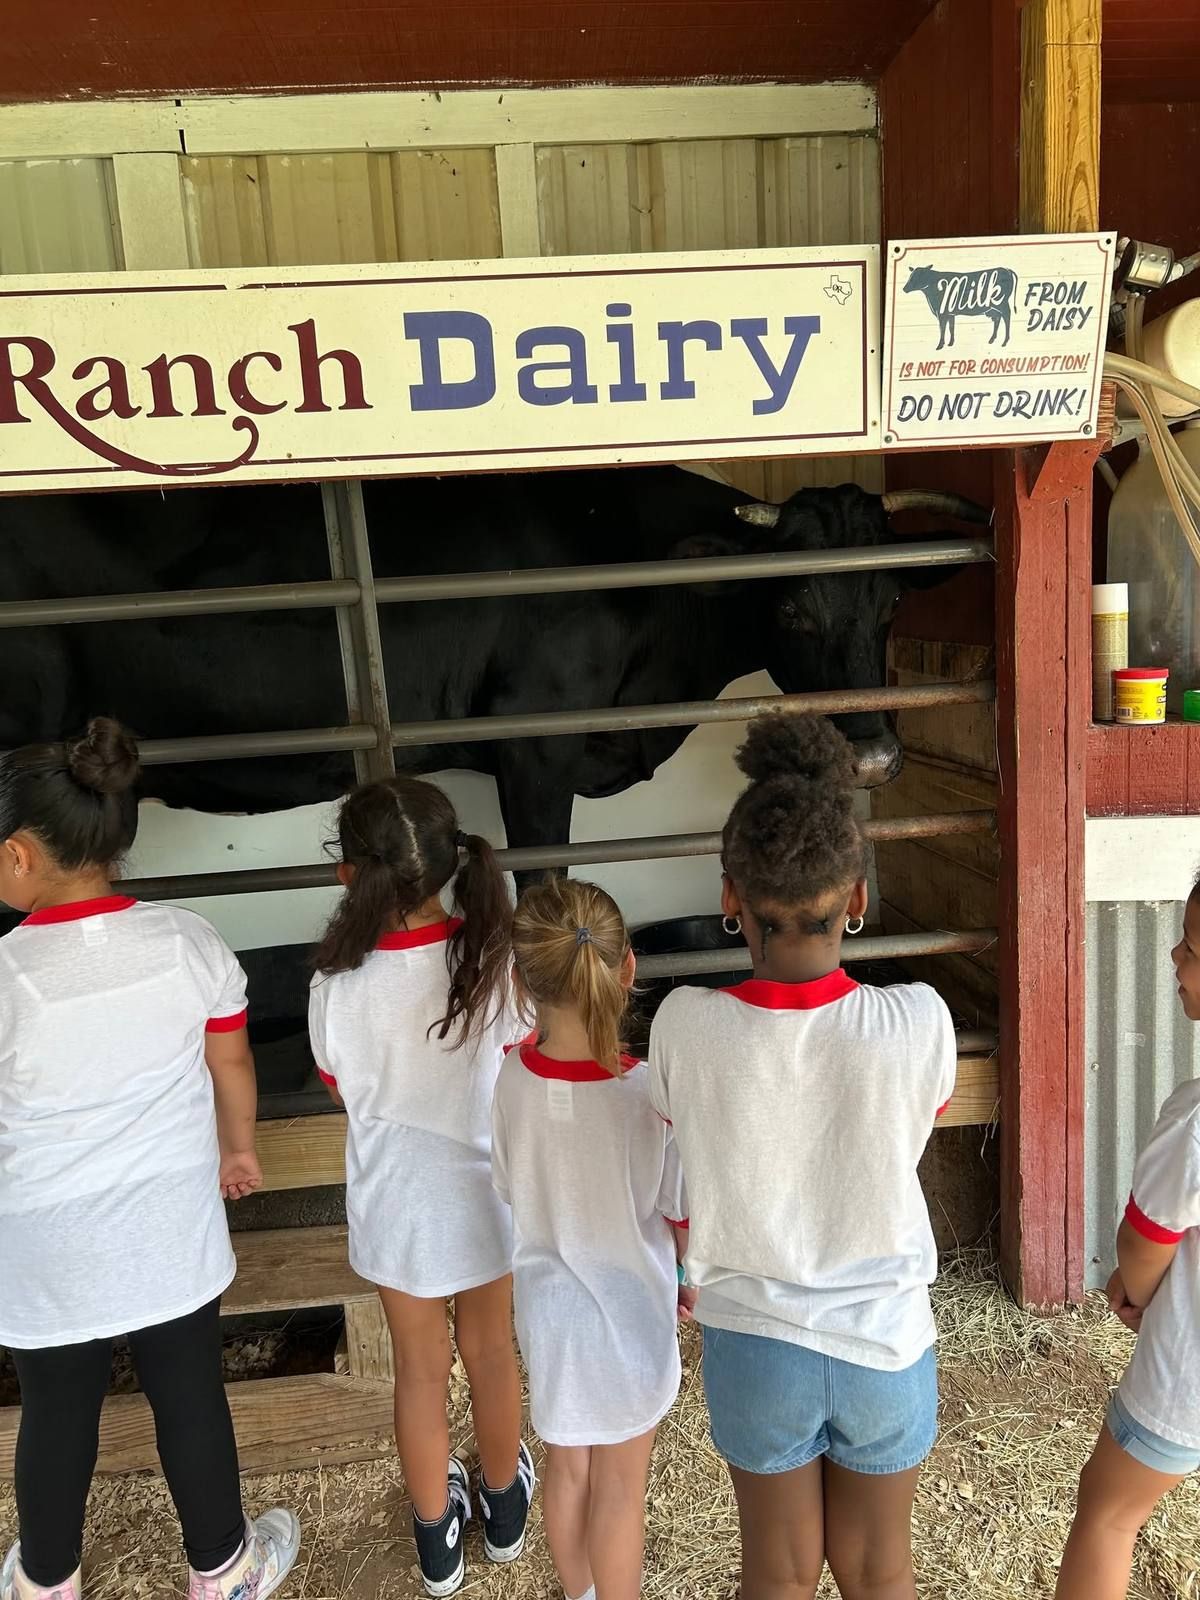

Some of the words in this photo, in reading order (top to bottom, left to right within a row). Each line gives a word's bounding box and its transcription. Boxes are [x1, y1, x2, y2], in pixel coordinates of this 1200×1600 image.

[938, 271, 1005, 314] Milk
[1024, 281, 1088, 306] FROM
[1027, 306, 1093, 332] DAISY
[899, 362, 914, 378] IS
[917, 360, 946, 377] NOT
[949, 358, 976, 375] FOR
[980, 353, 1091, 374] CONSUMPTION!
[0, 319, 373, 476] Ranch
[403, 302, 820, 415] Dairy
[897, 395, 932, 422] DO
[938, 392, 990, 421] NOT
[993, 388, 1087, 419] DRINK!
